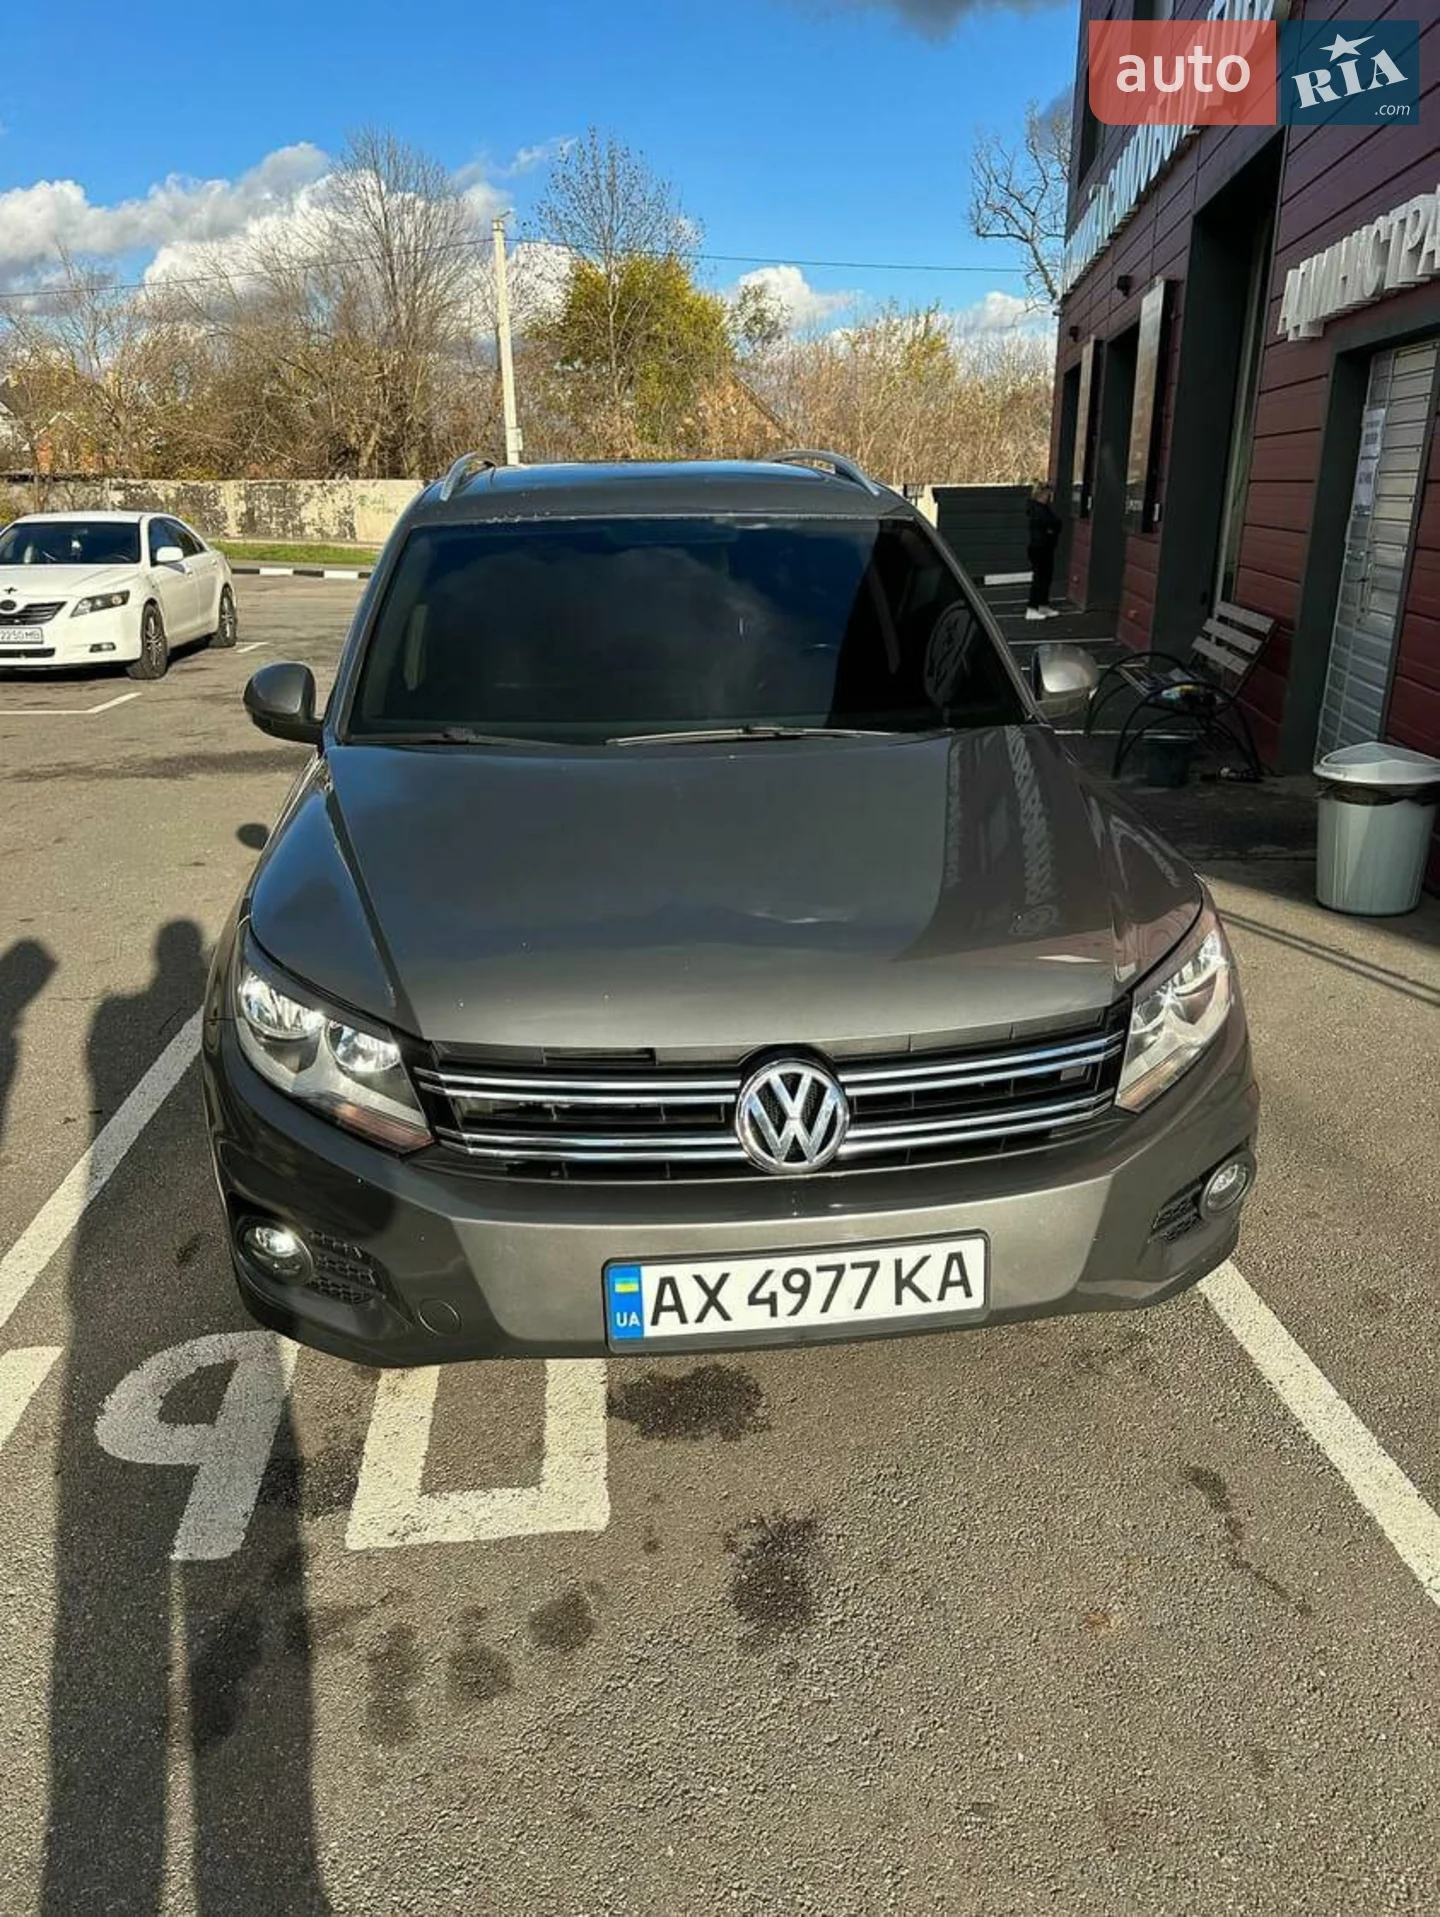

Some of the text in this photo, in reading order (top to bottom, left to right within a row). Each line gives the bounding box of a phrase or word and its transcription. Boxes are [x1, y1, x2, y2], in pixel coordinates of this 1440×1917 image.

[649, 1251, 974, 1327] AX 4977 KA
[615, 1311, 641, 1328] UA
